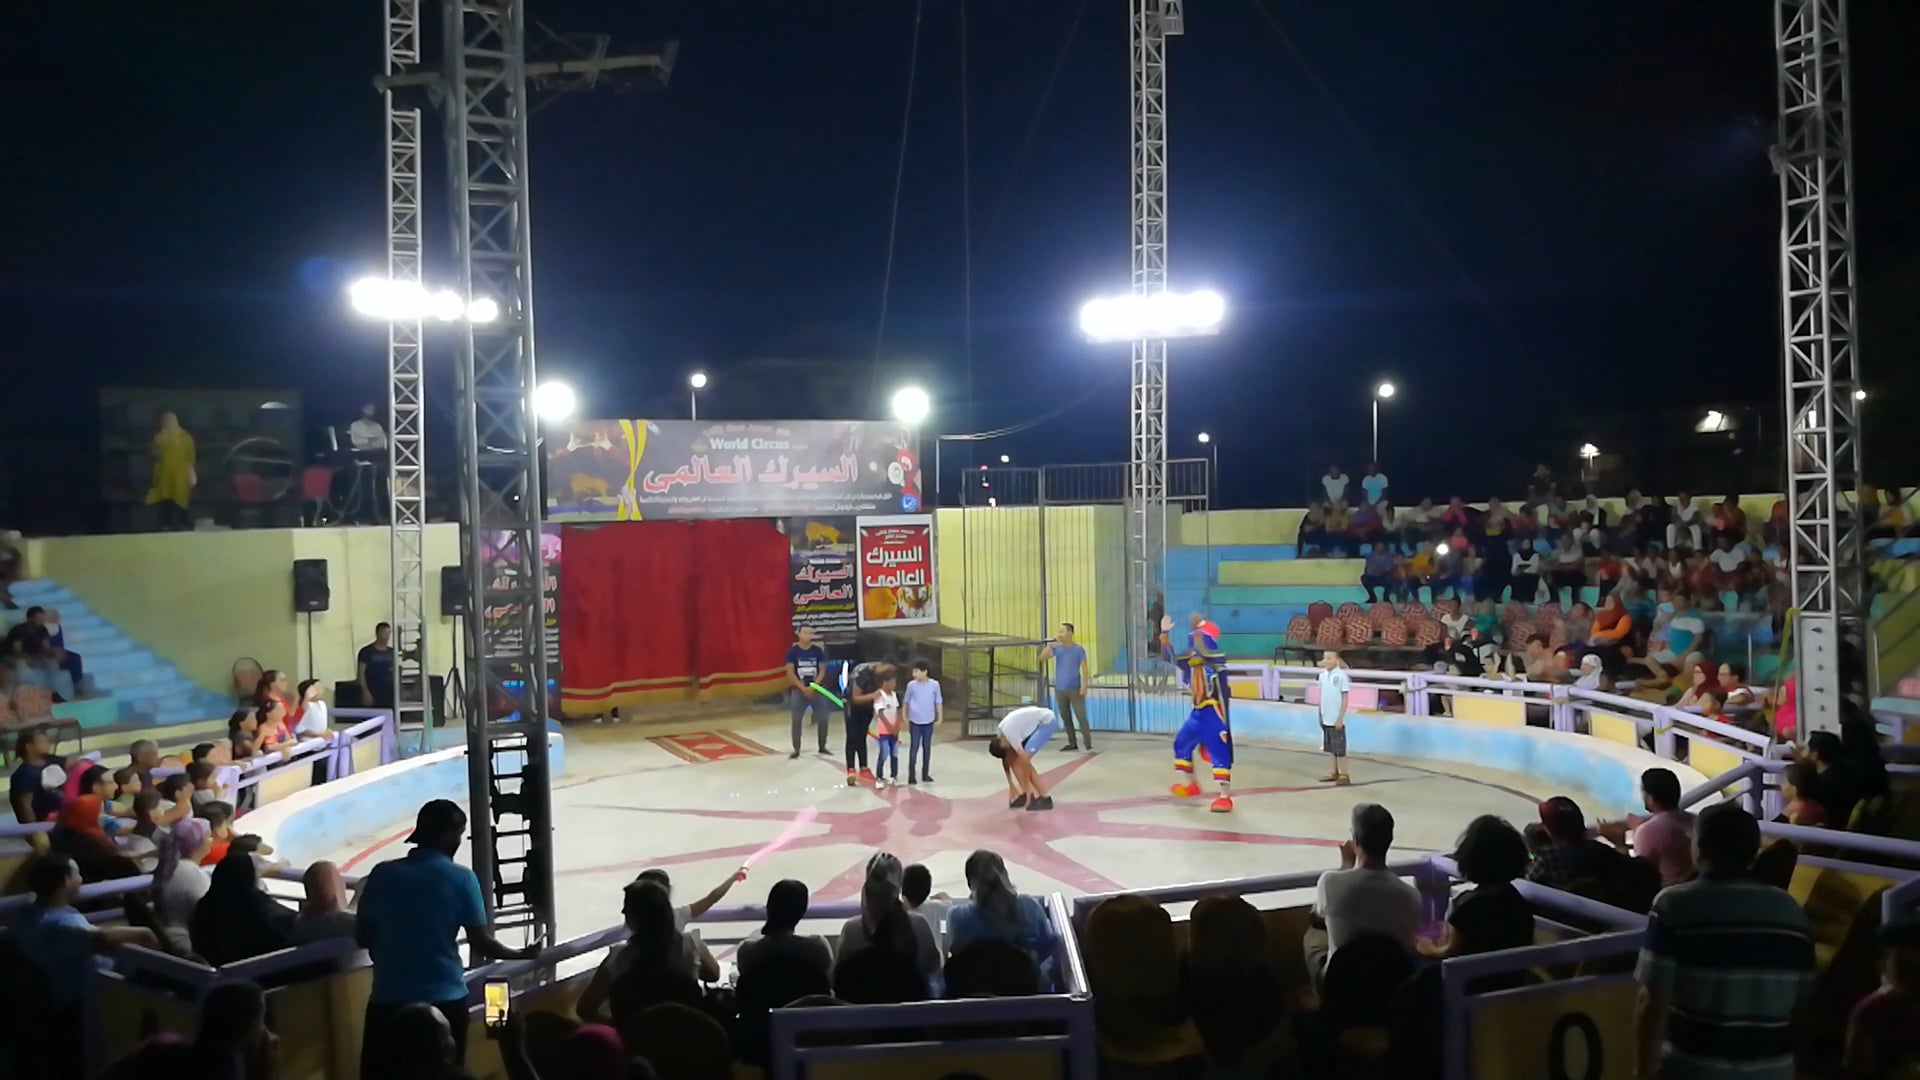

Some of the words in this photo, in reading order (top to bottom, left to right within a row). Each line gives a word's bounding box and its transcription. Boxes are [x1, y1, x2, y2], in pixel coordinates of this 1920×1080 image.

[709, 438, 748, 450] World
[751, 438, 790, 450] Circus
[758, 453, 858, 490] السيرك
[866, 545, 923, 567] السيرك
[795, 563, 854, 583] السيرك
